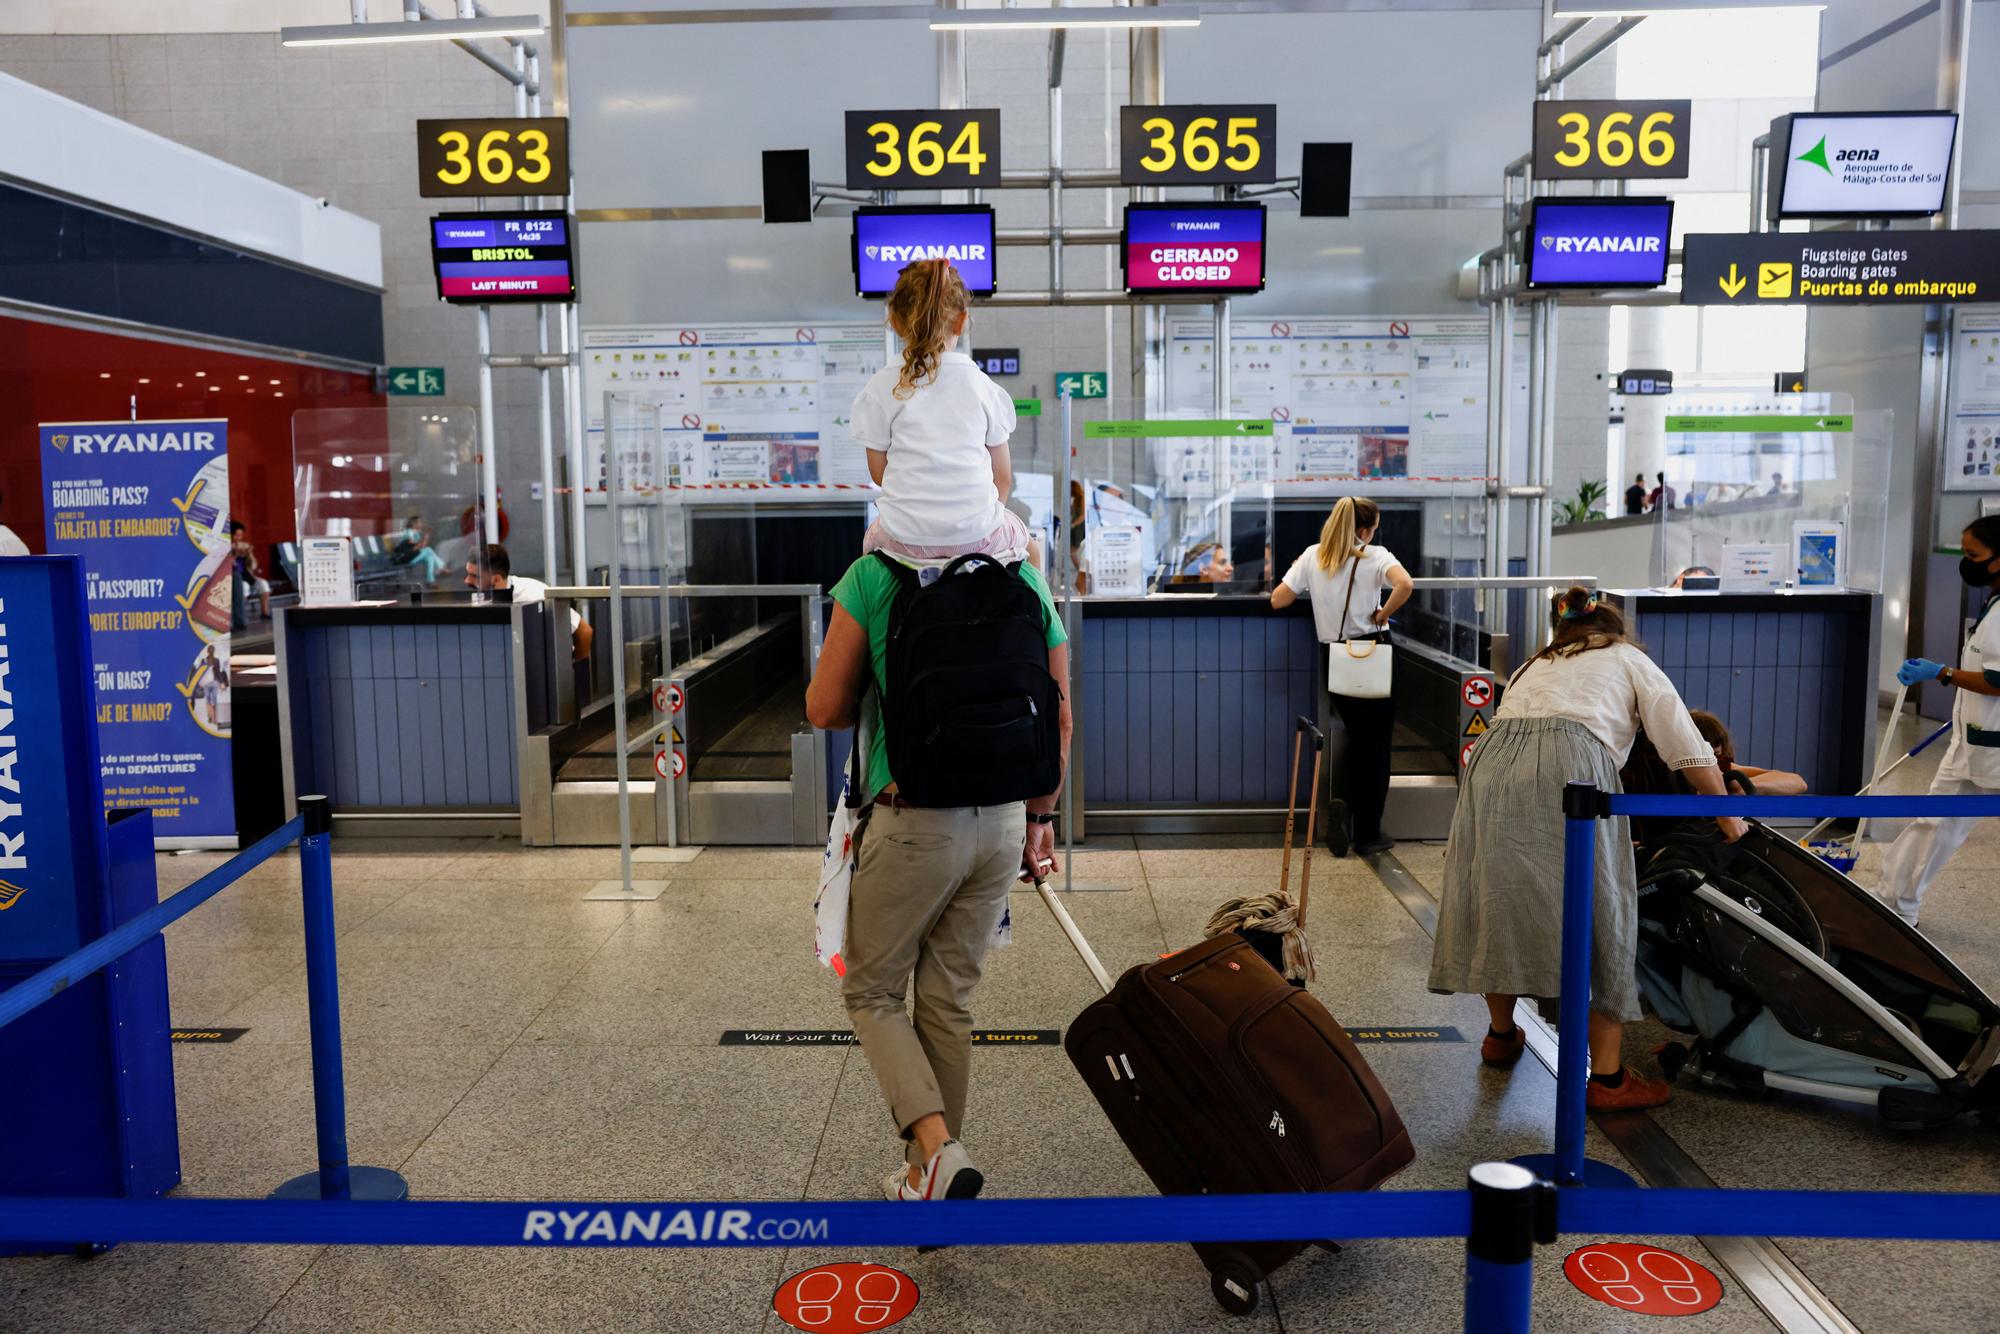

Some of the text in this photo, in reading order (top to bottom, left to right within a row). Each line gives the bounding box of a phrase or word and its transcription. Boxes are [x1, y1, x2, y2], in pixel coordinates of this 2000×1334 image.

[1139, 117, 1261, 172] 365
[1553, 111, 1675, 167] 366
[437, 130, 551, 184] 363
[865, 121, 987, 177] 364
[1835, 148, 1880, 161] aena
[1844, 163, 1913, 174] Aeropuerto de
[1843, 173, 1941, 185] Málaga-Costa del Sol
[504, 221, 553, 232] FR 8122
[1177, 222, 1221, 230] RYANAIR
[1556, 235, 1661, 253] RYANAIR
[471, 247, 535, 261] BRISTOL
[880, 245, 985, 261] RYANAIR
[1150, 248, 1239, 263] CERRADO
[1801, 248, 1908, 264] Flugsteige Gates
[1157, 266, 1231, 281] CLOSED
[1801, 264, 1897, 280] Boarding gates
[471, 280, 538, 291] LAST MINUTE
[1800, 279, 1977, 298] Puertas de embarque
[73, 432, 215, 454] RYANAIR
[53, 486, 149, 508] BOARDING PASS?
[54, 517, 180, 540] TARJETA DE EMBARQUE?
[99, 579, 164, 599] PASSPORT?
[122, 610, 182, 631] EUROPEO?
[117, 670, 151, 690] BAGS?
[115, 704, 129, 722] DE
[132, 702, 172, 722] MANO?
[106, 754, 118, 764] do
[119, 754, 135, 763] not
[136, 753, 158, 763] need
[160, 753, 171, 762] to
[172, 753, 205, 763] queue.
[116, 766, 126, 774] to
[128, 763, 197, 774] DEPARTURES
[116, 797, 180, 806] directamente
[744, 1032, 781, 1041] Wait
[785, 1034, 827, 1043] your
[986, 1033, 1040, 1041] turno
[522, 1209, 829, 1241] RYANAIR.COM
